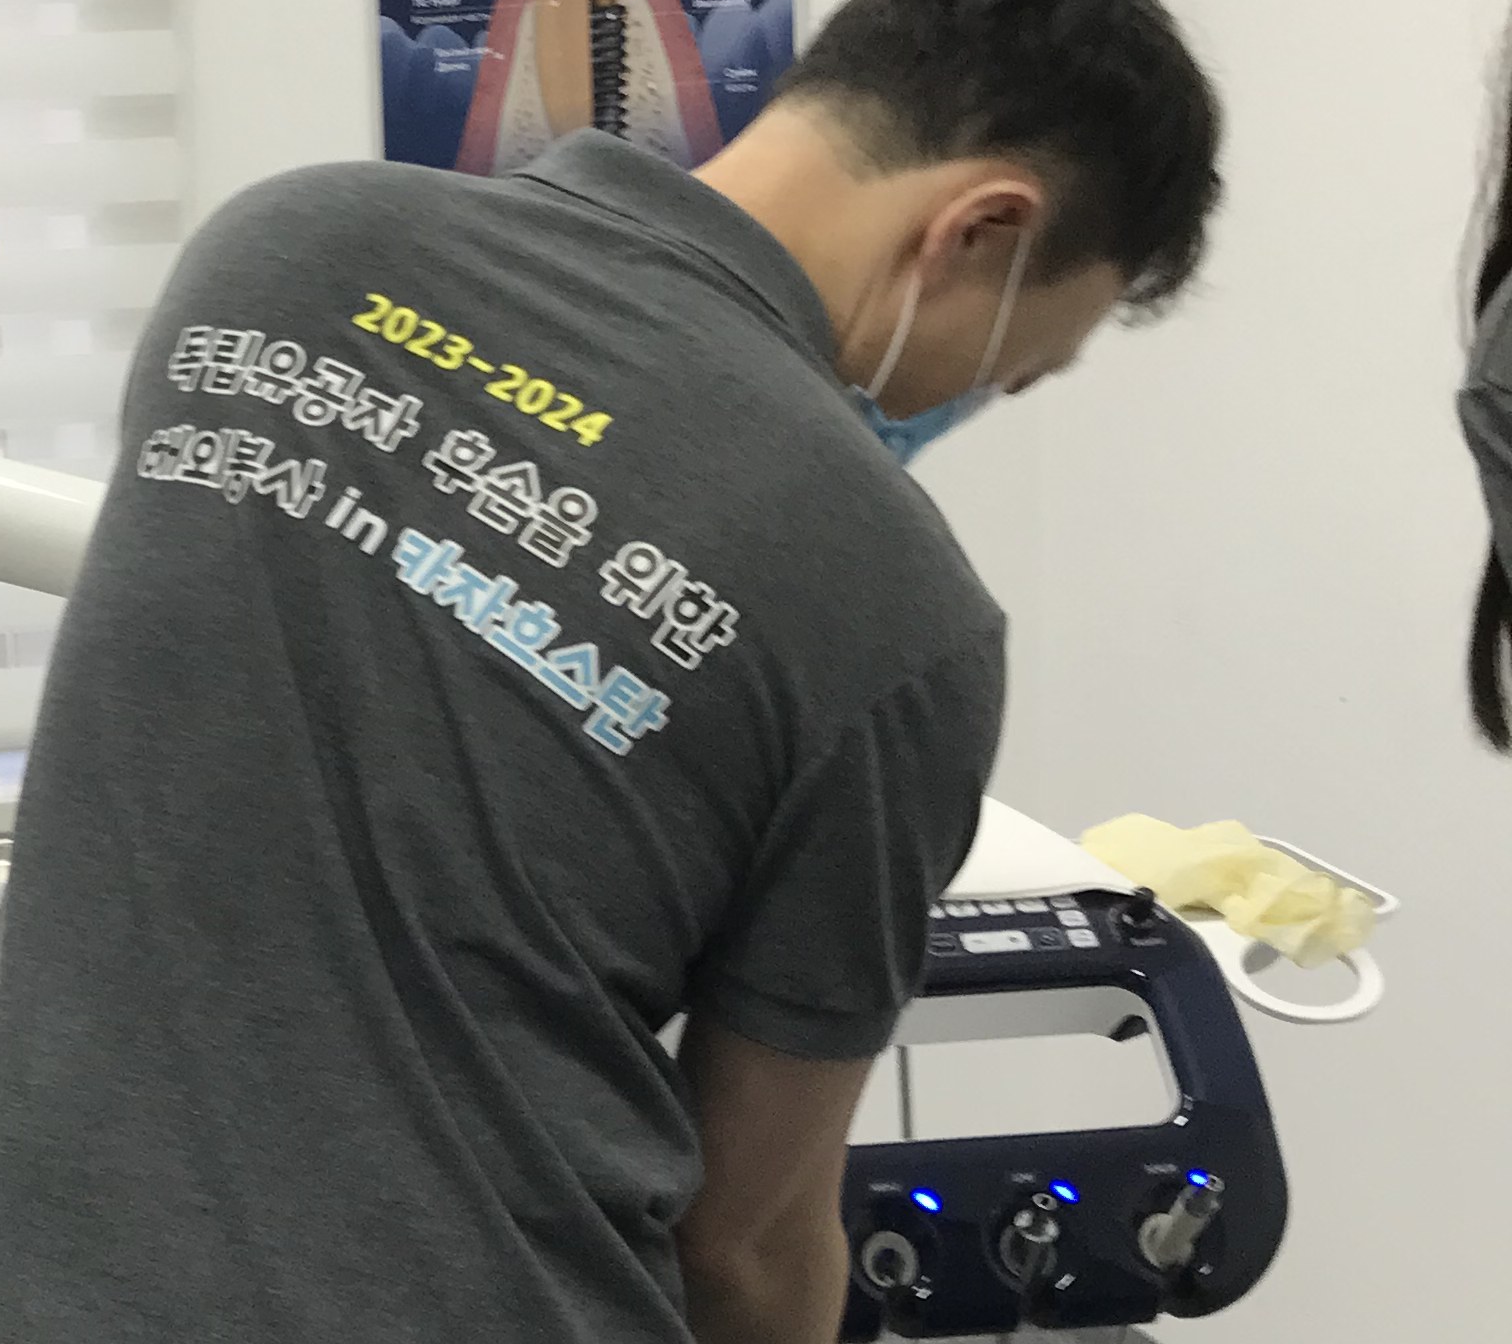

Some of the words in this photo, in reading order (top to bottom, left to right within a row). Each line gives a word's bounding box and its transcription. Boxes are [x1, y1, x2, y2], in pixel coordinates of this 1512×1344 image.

[353, 293, 614, 446] 2023-2024
[325, 486, 388, 555] in
[391, 526, 671, 757] 카자흐스탄
[421, 429, 598, 569] 후손을
[598, 540, 740, 670] 위한
